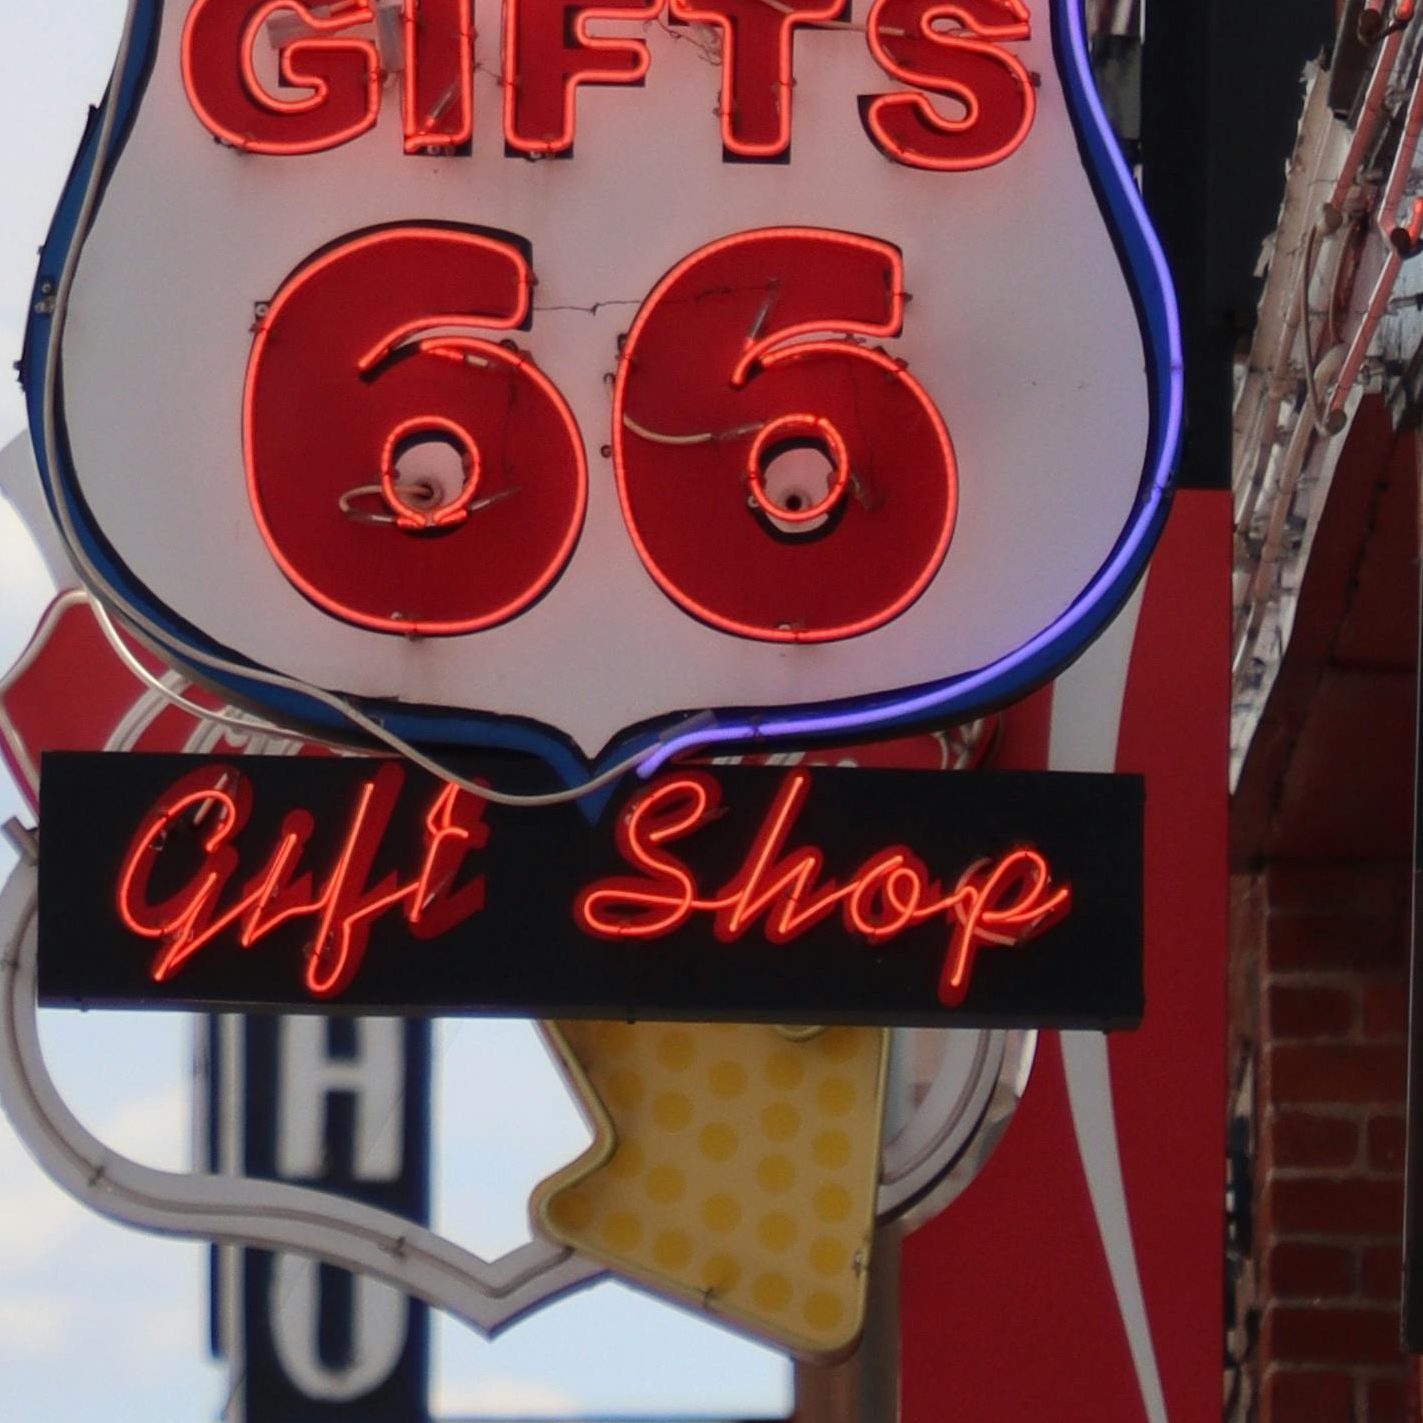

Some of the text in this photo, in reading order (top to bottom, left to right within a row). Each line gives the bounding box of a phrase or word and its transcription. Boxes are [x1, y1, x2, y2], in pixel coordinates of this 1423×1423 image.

[239, 220, 959, 644] 66
[115, 767, 1072, 997] Gift Shop
